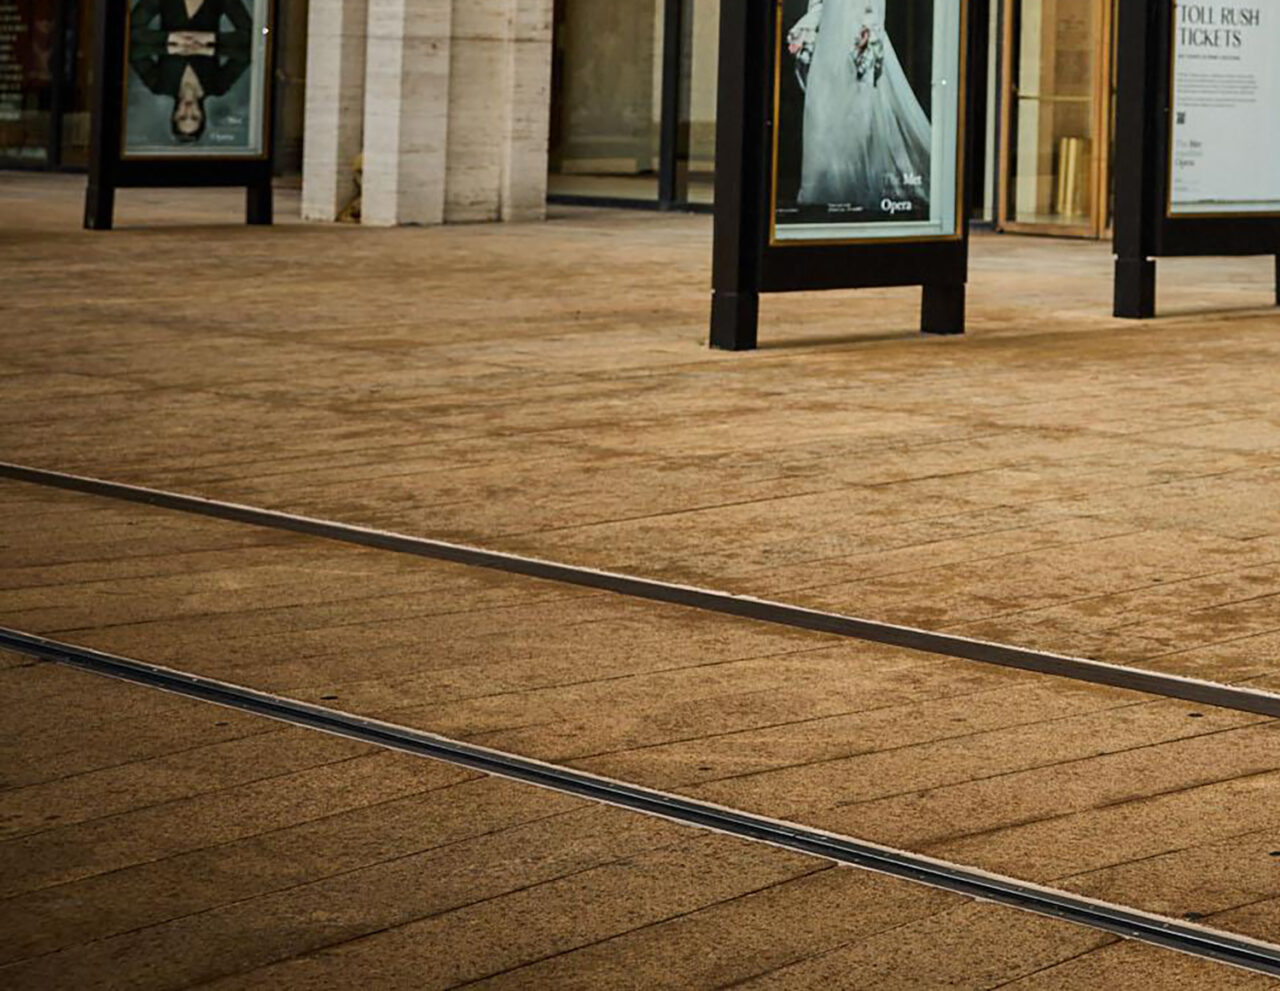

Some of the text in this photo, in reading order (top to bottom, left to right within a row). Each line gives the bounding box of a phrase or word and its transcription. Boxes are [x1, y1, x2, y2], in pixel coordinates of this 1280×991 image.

[1220, 6, 1260, 26] RUSH
[1180, 27, 1242, 48] TICKETS
[880, 198, 912, 214] Opera
